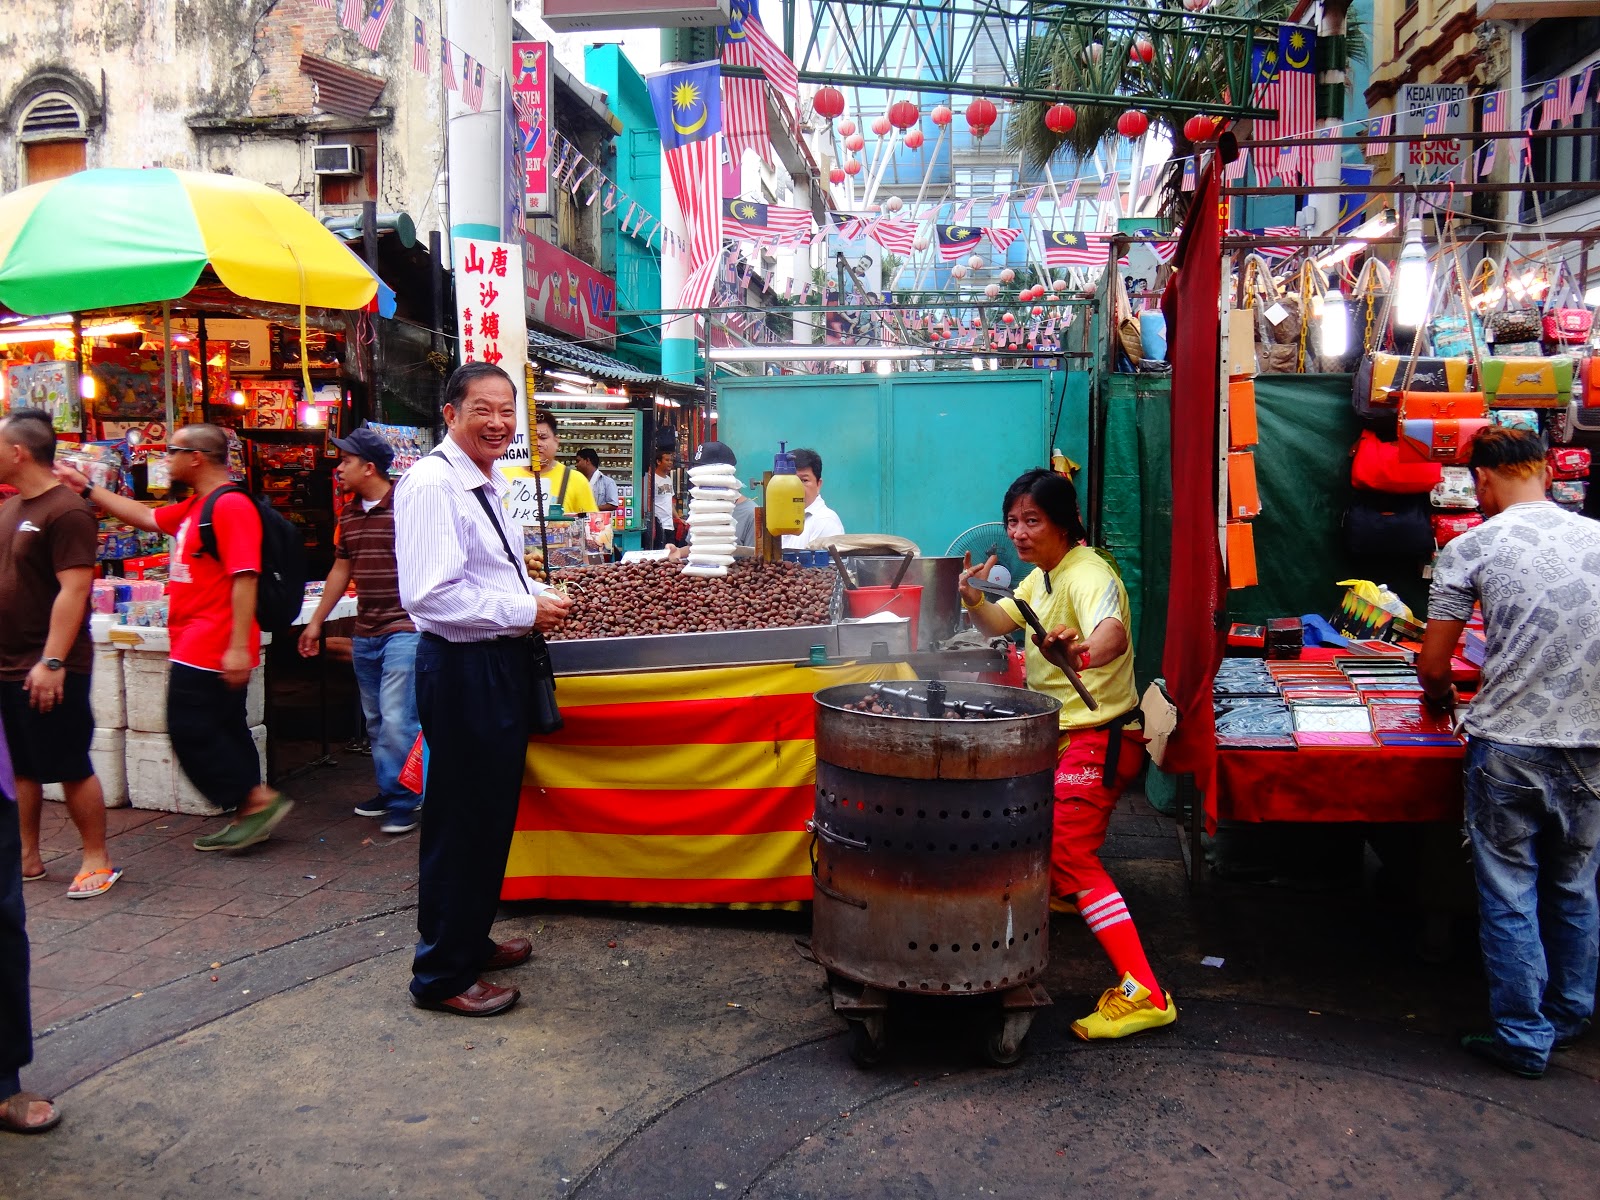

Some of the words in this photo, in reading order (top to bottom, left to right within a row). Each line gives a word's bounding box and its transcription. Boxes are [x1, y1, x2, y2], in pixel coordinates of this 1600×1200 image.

[1406, 86, 1434, 101] KEDAI
[1436, 87, 1464, 102] VIDEO
[1409, 151, 1459, 165] KONG
[510, 433, 524, 444] UT
